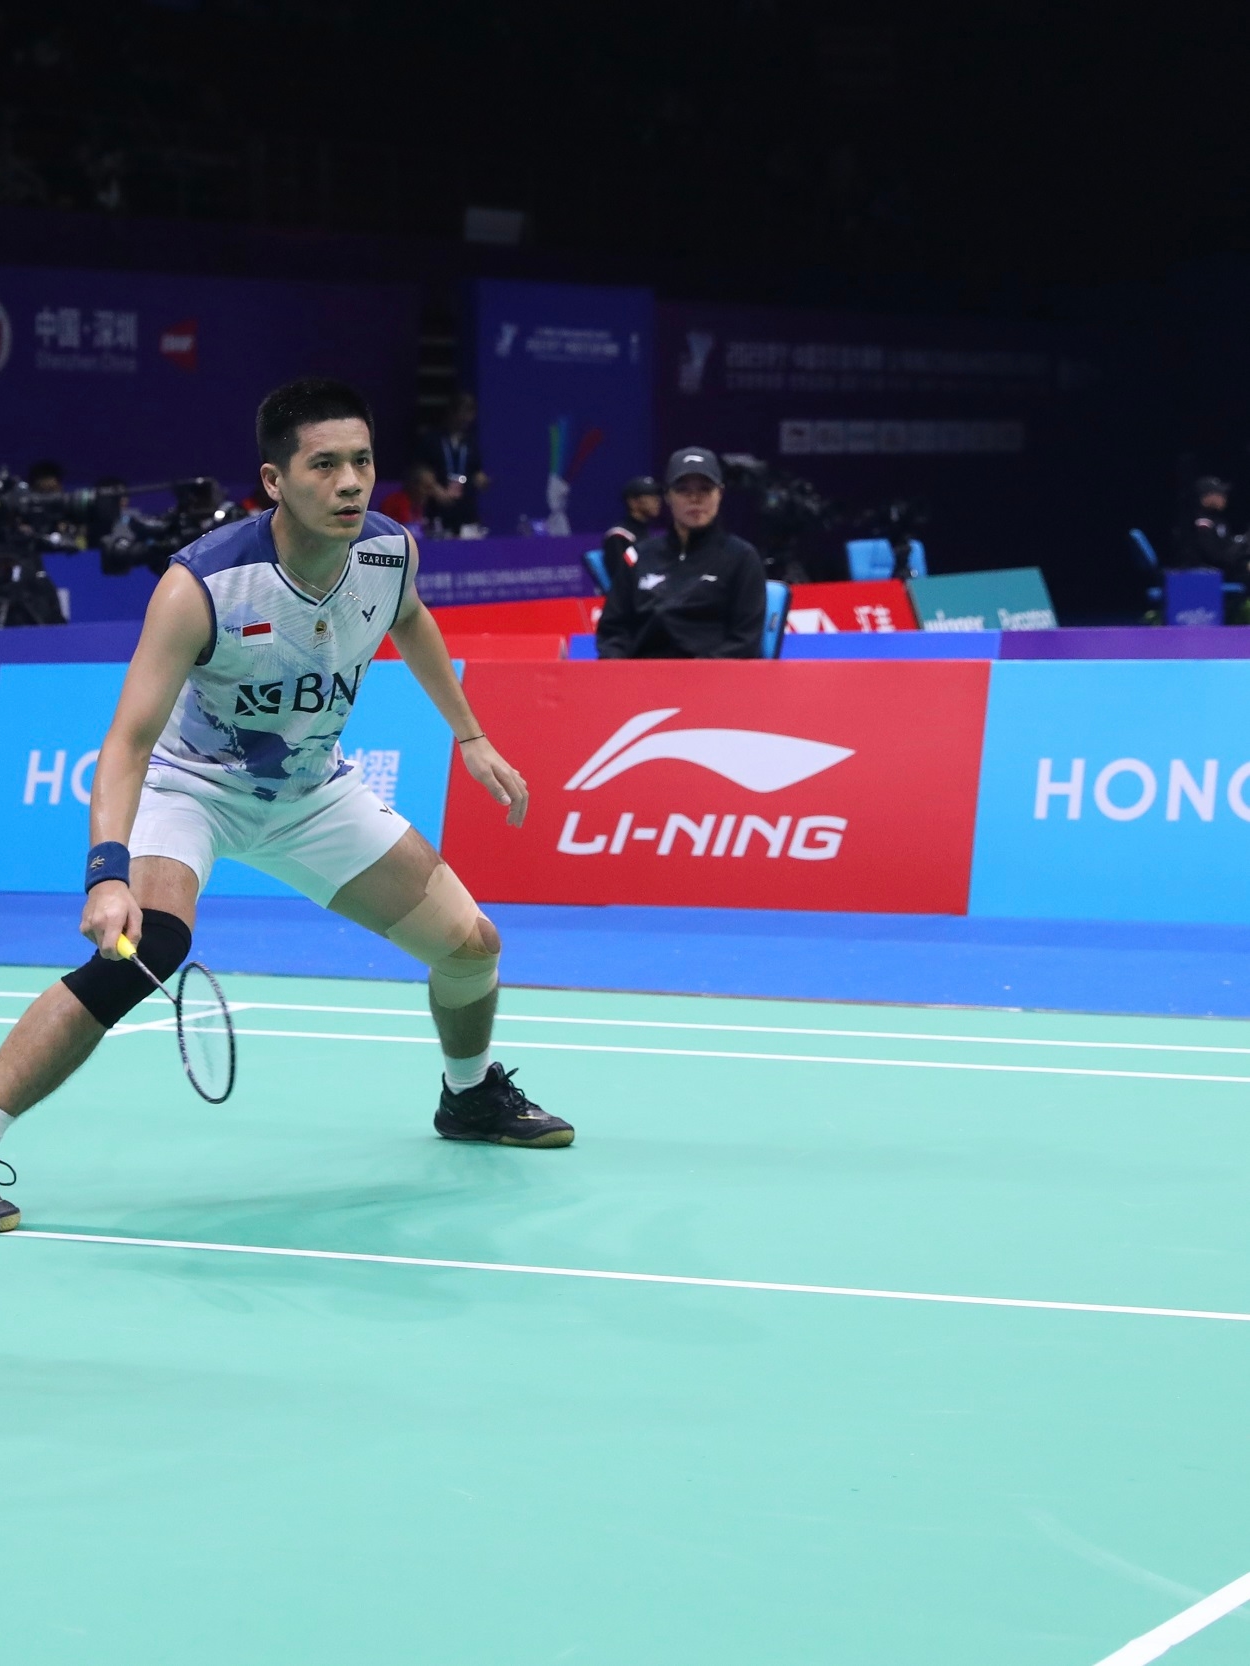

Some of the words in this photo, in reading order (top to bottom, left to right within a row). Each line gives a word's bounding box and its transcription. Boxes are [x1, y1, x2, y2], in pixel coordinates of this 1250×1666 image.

[357, 552, 404, 567] SCARLETT
[291, 658, 372, 714] BN
[556, 811, 848, 861] LI-NING
